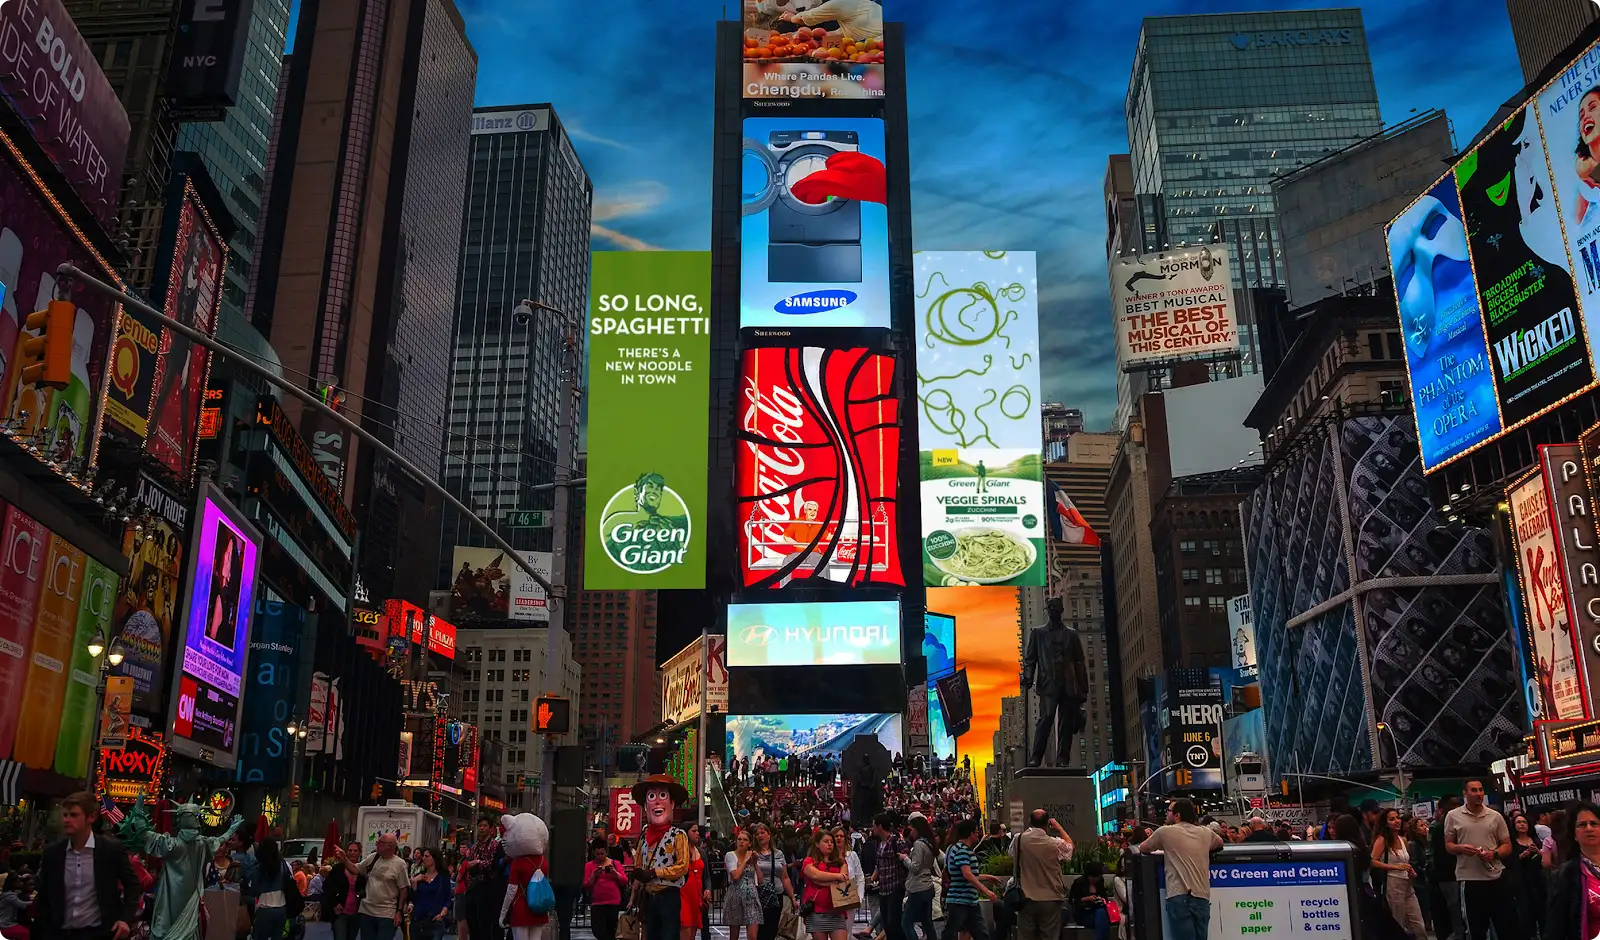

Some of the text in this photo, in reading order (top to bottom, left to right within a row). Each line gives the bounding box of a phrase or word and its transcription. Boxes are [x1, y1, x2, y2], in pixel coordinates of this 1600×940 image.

[1255, 27, 1351, 47] BARCLAYS
[36, 15, 85, 103] BOLD
[183, 55, 217, 68] NYC
[764, 72, 865, 81] Where Pandas Live.
[1560, 61, 1582, 89] THE
[746, 82, 826, 98] Chengdu,
[1548, 81, 1582, 117] NEVER
[0, 8, 108, 193] IDE OF WATER
[1160, 253, 1222, 276] MORMON
[598, 294, 703, 314] SO LONG,
[785, 297, 848, 307] SAMSUNG
[1125, 292, 1158, 303] WINNER
[1167, 288, 1190, 297] TONY
[1126, 293, 1226, 314] BEST MUSICAL
[1487, 283, 1519, 310] BIGGEST
[1173, 304, 1227, 324] BEST
[590, 317, 710, 335] SPAGHETTI
[1128, 320, 1228, 343] MUSICAL OF
[618, 348, 681, 358] THERE'S A
[1130, 341, 1161, 353] THIS
[112, 333, 140, 400] Q
[606, 361, 692, 371] NEW NOODLE
[1437, 352, 1455, 372] The
[621, 374, 676, 384] IN TOWN
[1418, 353, 1485, 408] PHANTOM
[1441, 387, 1464, 409] of the
[1432, 401, 1478, 437] OPERA
[744, 375, 804, 564] Coca-Cola
[948, 480, 1010, 488] Green Giant
[145, 483, 165, 514] JOY
[164, 495, 188, 529] RIDE!
[936, 496, 1027, 505] VEGGIE SPIRALS
[517, 512, 530, 526] 46
[532, 512, 540, 520] ST
[945, 516, 954, 524] 2g
[610, 523, 686, 543] Green
[930, 534, 950, 545] 100%
[4, 523, 42, 582] ICE
[927, 539, 956, 551] ZUCCHINI
[527, 556, 539, 566] By
[619, 545, 688, 565] Giant
[47, 548, 79, 603] ICE
[84, 571, 113, 622] ICE
[519, 583, 543, 593] did it.
[435, 630, 454, 649] PLAZA
[785, 625, 888, 643] HYUNDAI
[121, 632, 162, 657] MOTOWN
[249, 641, 271, 653] organ
[1180, 704, 1223, 725] HERO
[1183, 732, 1211, 743] JUNE 6
[104, 748, 158, 776] ROXY
[434, 718, 446, 802] HERSHES
[1527, 789, 1575, 806] BOX OFFICE HERE
[617, 791, 637, 832] tkts
[1286, 809, 1300, 818] OUT
[368, 821, 411, 830] TOUR FOR LIFE
[1231, 867, 1269, 879] Green
[1272, 867, 1296, 878] and
[1299, 866, 1338, 878] Clean!
[1235, 899, 1274, 911] recycle
[1301, 897, 1340, 909] recycle
[1249, 911, 1262, 921] all
[1302, 909, 1340, 919] bottles
[1241, 923, 1272, 934] paper
[1304, 922, 1341, 932] & cans
